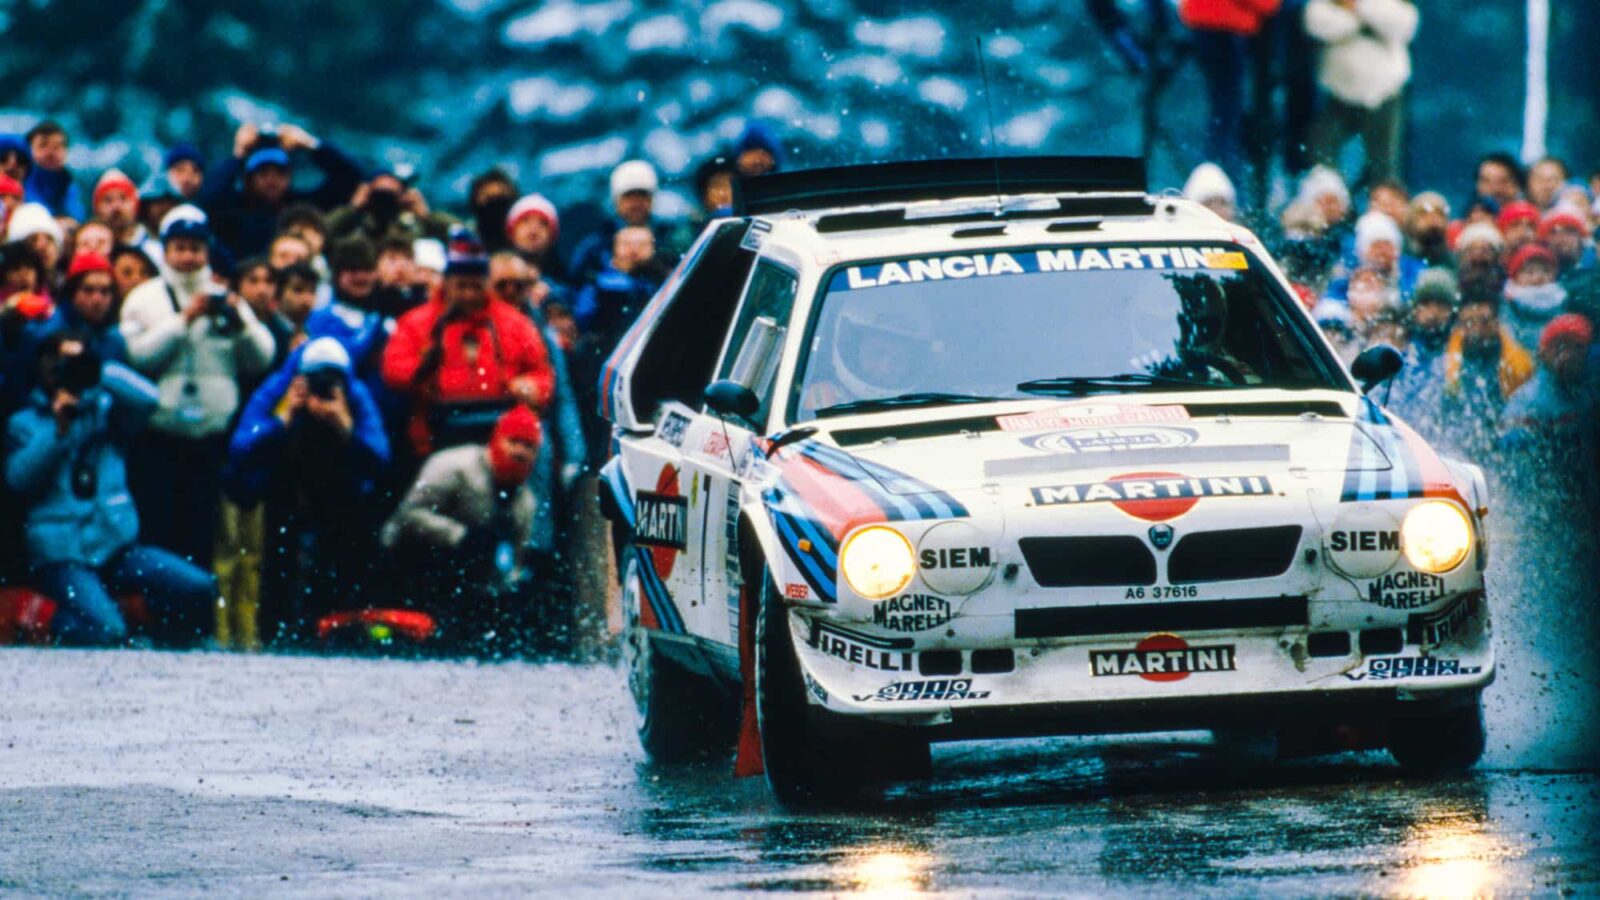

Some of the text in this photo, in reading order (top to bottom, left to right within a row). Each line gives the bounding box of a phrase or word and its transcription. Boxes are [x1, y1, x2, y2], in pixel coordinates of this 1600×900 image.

[847, 252, 1025, 289] LANCIA
[1039, 476, 1265, 504] MARTINI
[1330, 530, 1400, 552] SIEM
[920, 546, 991, 570] SIEM
[1125, 585, 1197, 600] A6 37616
[1368, 571, 1445, 593] MAGNETI
[873, 594, 951, 614] MAGNETI
[873, 612, 951, 633] MARELLI
[1096, 648, 1230, 675] MARTINI
[880, 680, 971, 694] OLIO
